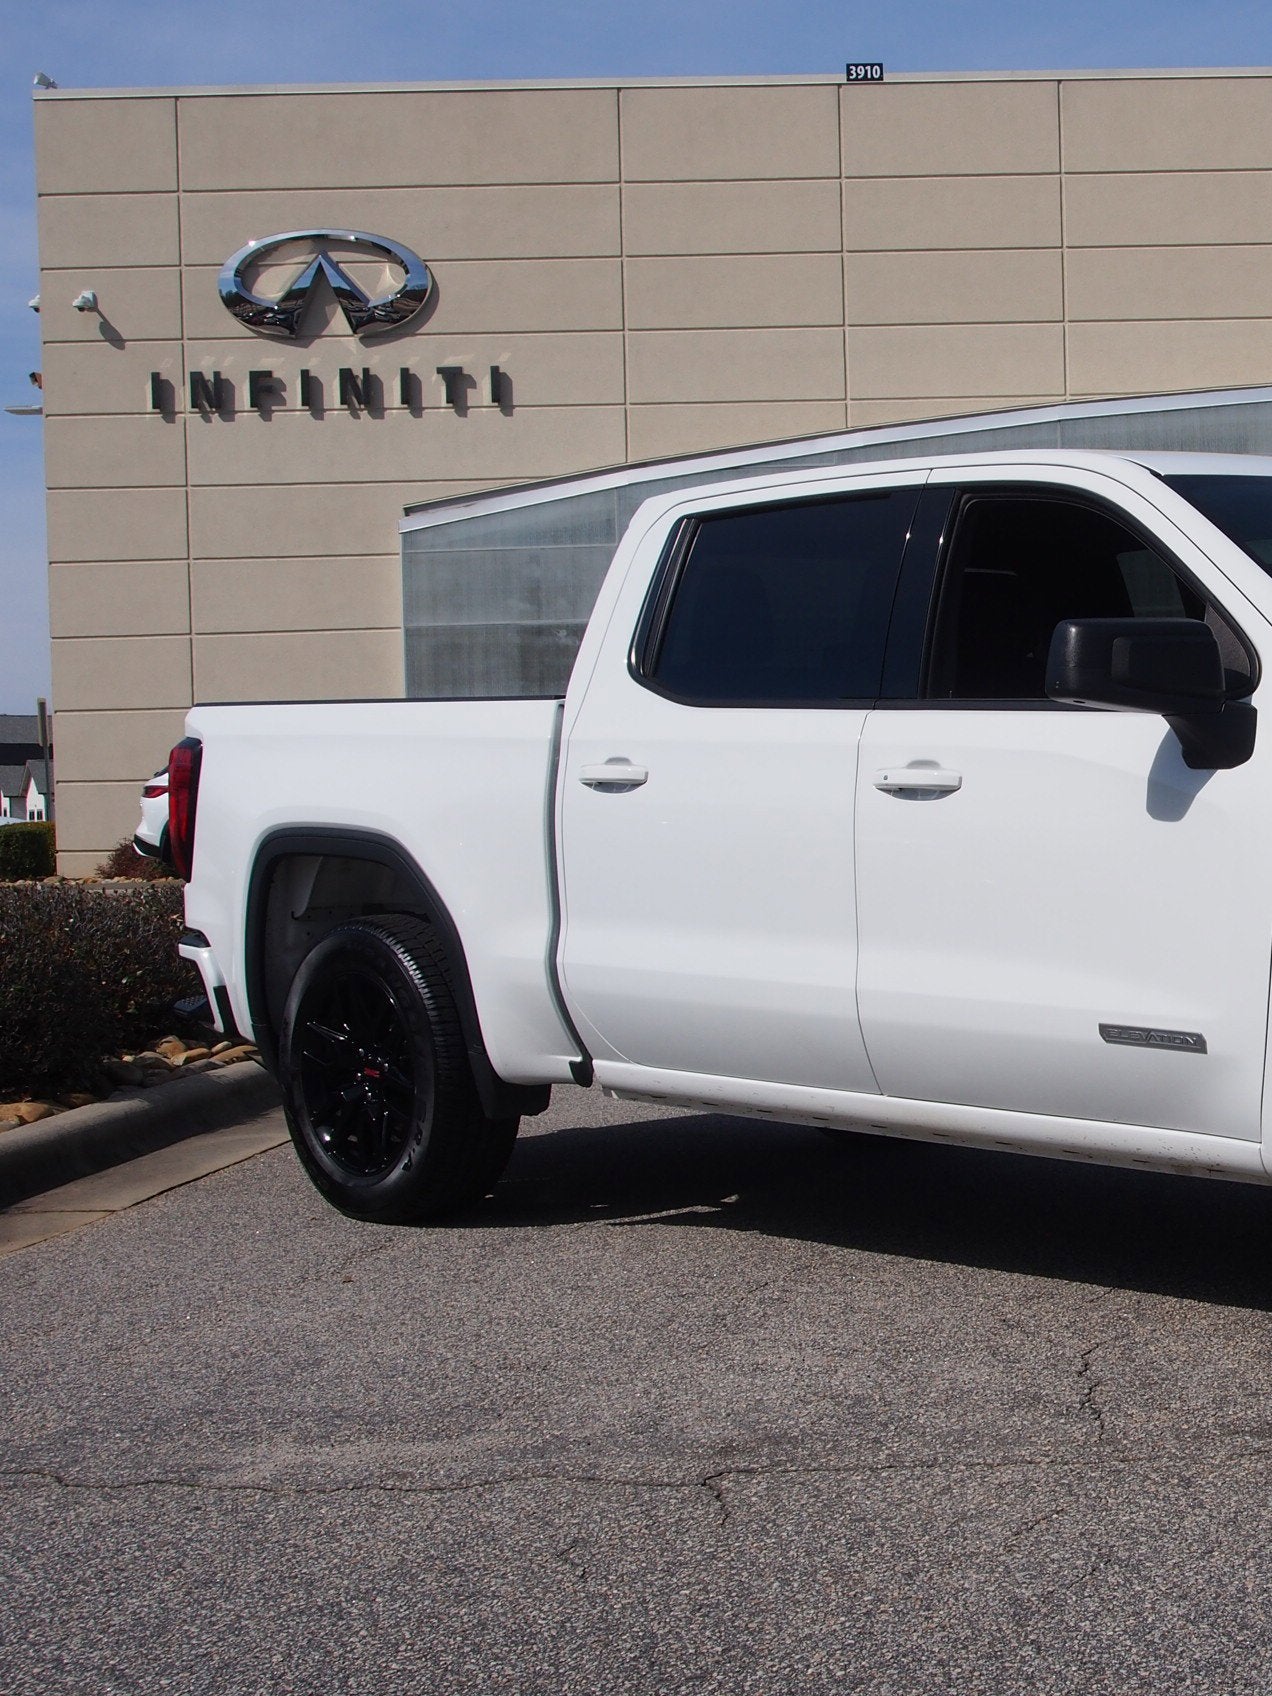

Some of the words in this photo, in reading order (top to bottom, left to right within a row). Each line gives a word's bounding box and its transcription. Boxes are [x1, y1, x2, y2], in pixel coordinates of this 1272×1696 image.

[849, 65, 881, 79] 3910
[151, 365, 507, 411] INFINITI
[1106, 1027, 1198, 1046] ELEVATION
